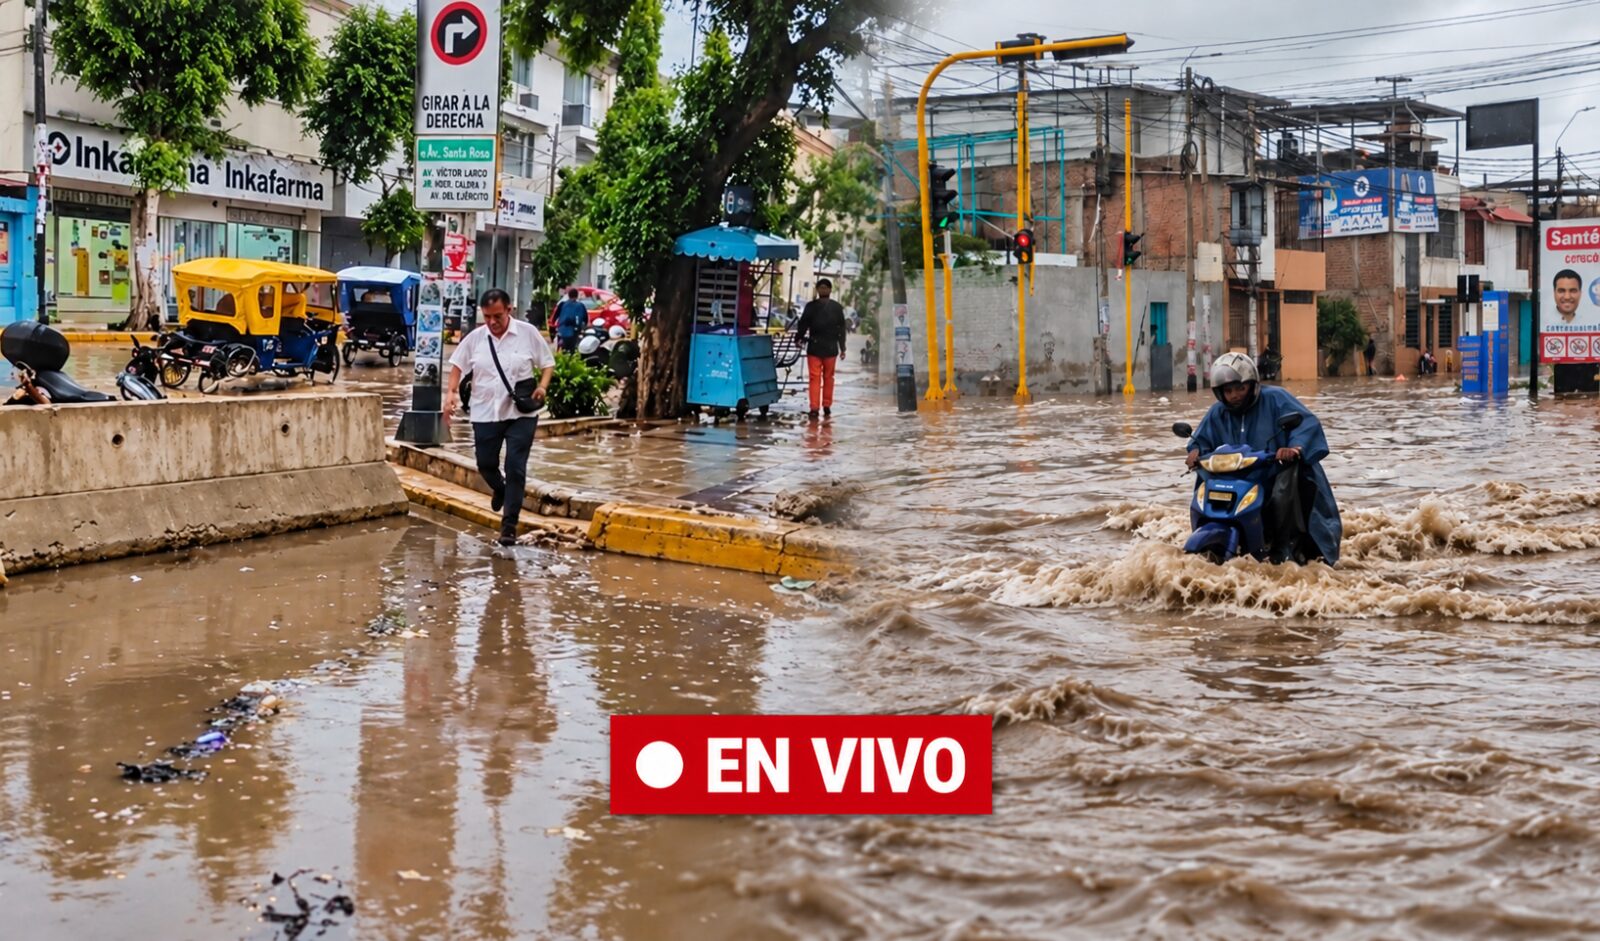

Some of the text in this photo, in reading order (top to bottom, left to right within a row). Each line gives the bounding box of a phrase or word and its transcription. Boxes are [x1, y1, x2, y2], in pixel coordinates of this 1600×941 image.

[421, 95, 490, 111] GIRAR A LA
[426, 113, 484, 128] DERECHA
[443, 146, 467, 159] Santa
[464, 169, 488, 178] LARCO
[225, 161, 324, 201] Inkafarma
[442, 192, 454, 200] DEL
